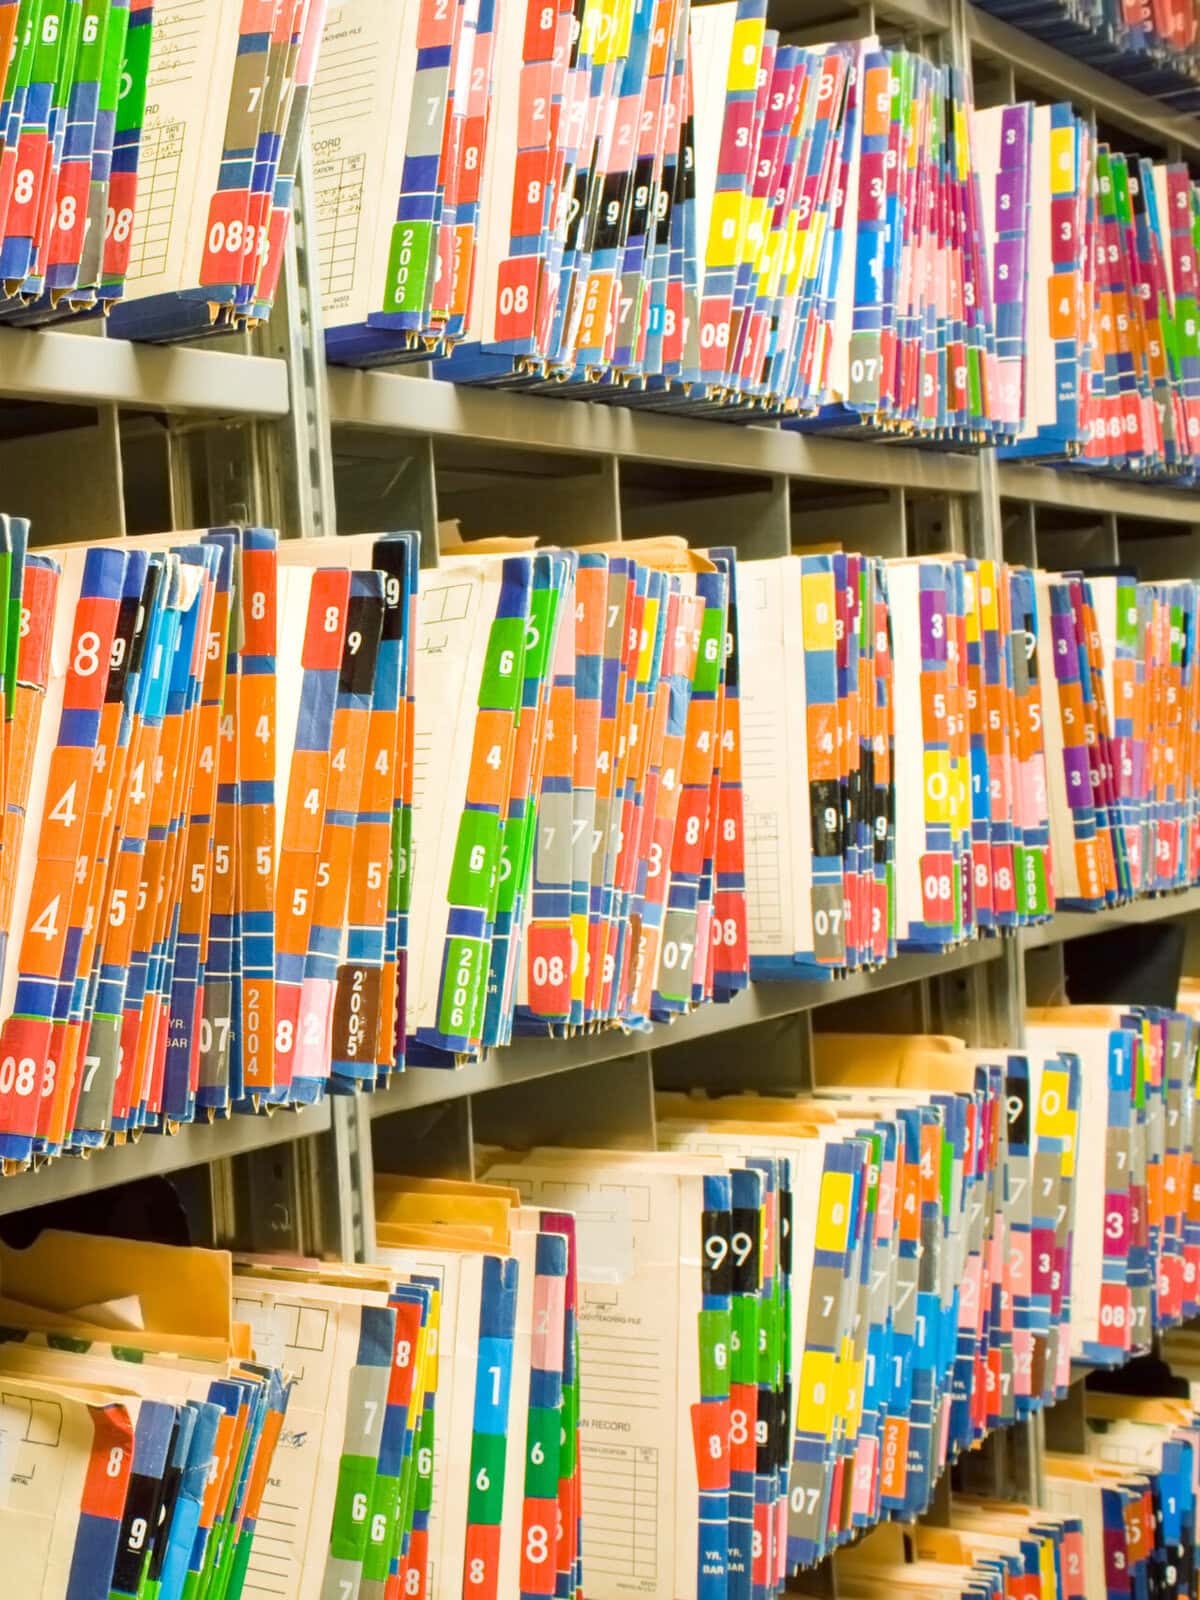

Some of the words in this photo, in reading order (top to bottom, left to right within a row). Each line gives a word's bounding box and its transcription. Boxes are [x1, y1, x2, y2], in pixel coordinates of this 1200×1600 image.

[83, 16, 98, 42] 6
[540, 8, 553, 30] 8
[818, 74, 834, 98] 8
[246, 88, 261, 113] 7
[313, 137, 341, 151] CORD
[619, 125, 630, 145] 2
[735, 127, 748, 148] 3
[1006, 130, 1016, 144] 3
[464, 148, 478, 170] 8
[870, 178, 883, 196] 3
[1177, 192, 1187, 208] 3
[208, 221, 242, 253] 08
[721, 219, 735, 239] 0
[393, 230, 415, 304] 2006
[500, 287, 529, 314] 08
[579, 279, 599, 345] 2004
[1059, 297, 1070, 316] 4
[702, 323, 728, 348] 08
[1185, 318, 1195, 335] 6
[851, 359, 877, 382] 07
[324, 607, 338, 632] 8
[608, 606, 618, 627] 7
[816, 603, 828, 623] 0
[931, 614, 943, 638] 3
[73, 632, 100, 676] 8
[500, 651, 513, 672] 6
[705, 639, 717, 659] 6
[1064, 708, 1074, 723] 5
[256, 714, 270, 744] 4
[822, 732, 833, 753] 4
[487, 745, 501, 769] 4
[928, 773, 946, 800] 0
[49, 779, 77, 827] 4
[304, 788, 319, 815] 4
[686, 816, 699, 844] 8
[470, 845, 485, 868] 6
[191, 863, 205, 894] 5
[925, 876, 950, 899] 08
[1025, 856, 1037, 908] 2006
[109, 890, 128, 926] 5
[292, 889, 308, 915] 5
[29, 894, 60, 941] 4
[815, 910, 841, 935] 07
[664, 943, 693, 969] 07
[533, 956, 563, 985] 08
[451, 949, 472, 1025] 2006
[347, 970, 362, 1055] 2005
[201, 1018, 228, 1051] 07
[248, 990, 259, 1076] 2004
[83, 1056, 99, 1091] 7
[1113, 1050, 1123, 1075] 1
[0, 1058, 35, 1095] 08
[1007, 1096, 1023, 1125] 9
[904, 1194, 914, 1214] 4
[1106, 1213, 1123, 1238] 3
[731, 1233, 752, 1267] 9
[822, 1297, 834, 1316] 7
[1102, 1306, 1125, 1327] 08
[396, 1341, 411, 1367] 8
[488, 1367, 501, 1405] 1
[592, 1420, 631, 1432] RECORD
[730, 1410, 747, 1444] 8
[106, 1447, 123, 1478] 8
[417, 1448, 431, 1474] 6
[883, 1425, 898, 1487] 2004
[792, 1490, 819, 1514] 07
[128, 1518, 147, 1548] 9
[526, 1525, 548, 1563] 8
[705, 1551, 721, 1560] YR.
[405, 1569, 420, 1595] 8
[703, 1564, 724, 1575] BAR
[1166, 1566, 1176, 1584] 9
